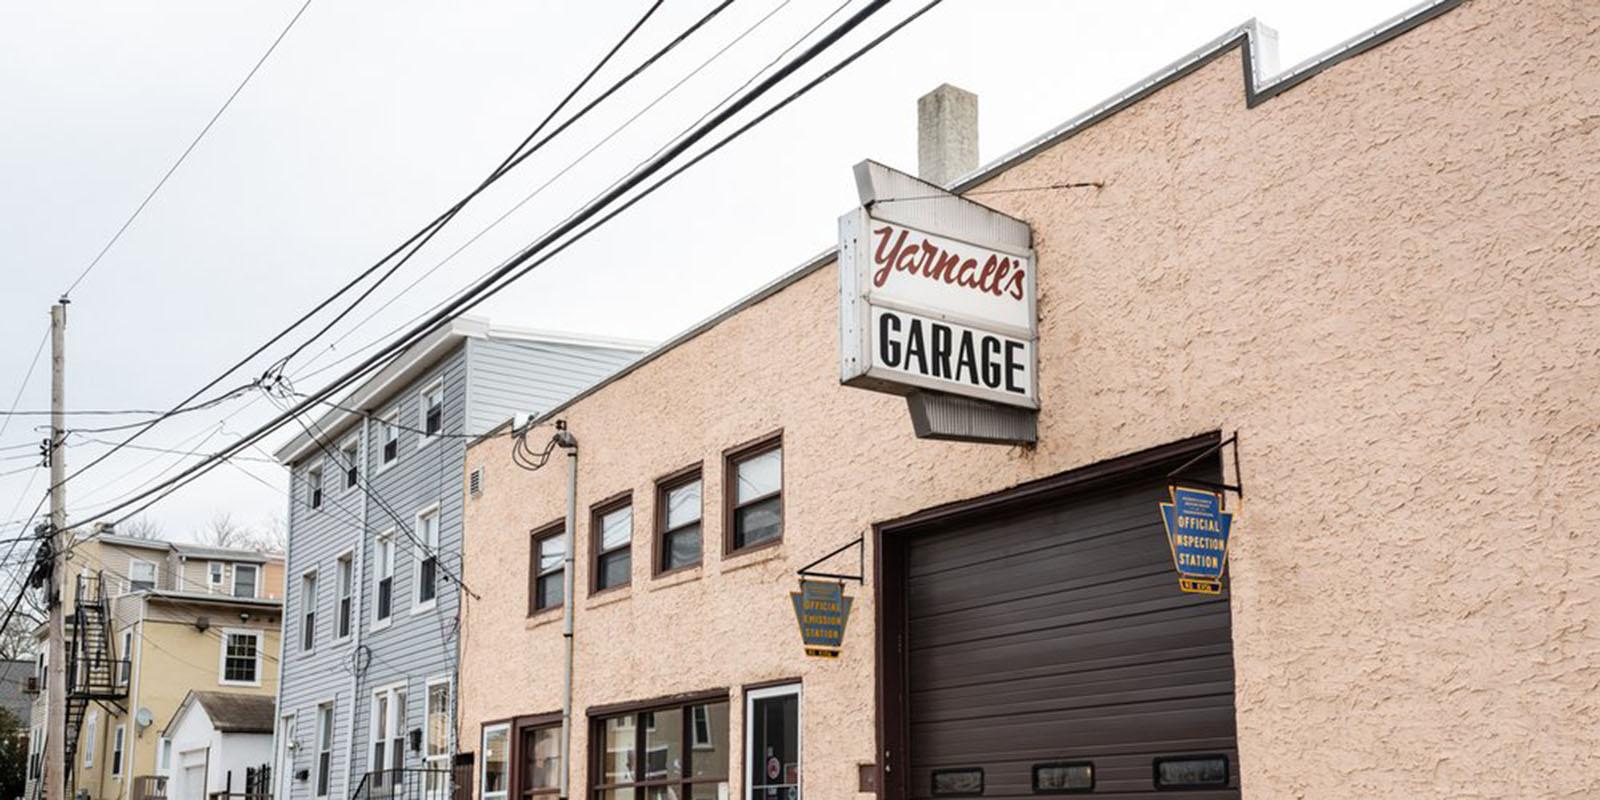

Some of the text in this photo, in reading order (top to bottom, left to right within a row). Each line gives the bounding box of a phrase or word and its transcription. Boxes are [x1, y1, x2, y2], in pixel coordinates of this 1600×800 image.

[873, 226, 1025, 300] Yarnall's
[879, 312, 1025, 394] GARAGE
[1178, 516, 1220, 532] OFFICIAL
[1179, 553, 1218, 568] STATION
[803, 600, 839, 611] OFFICIAL
